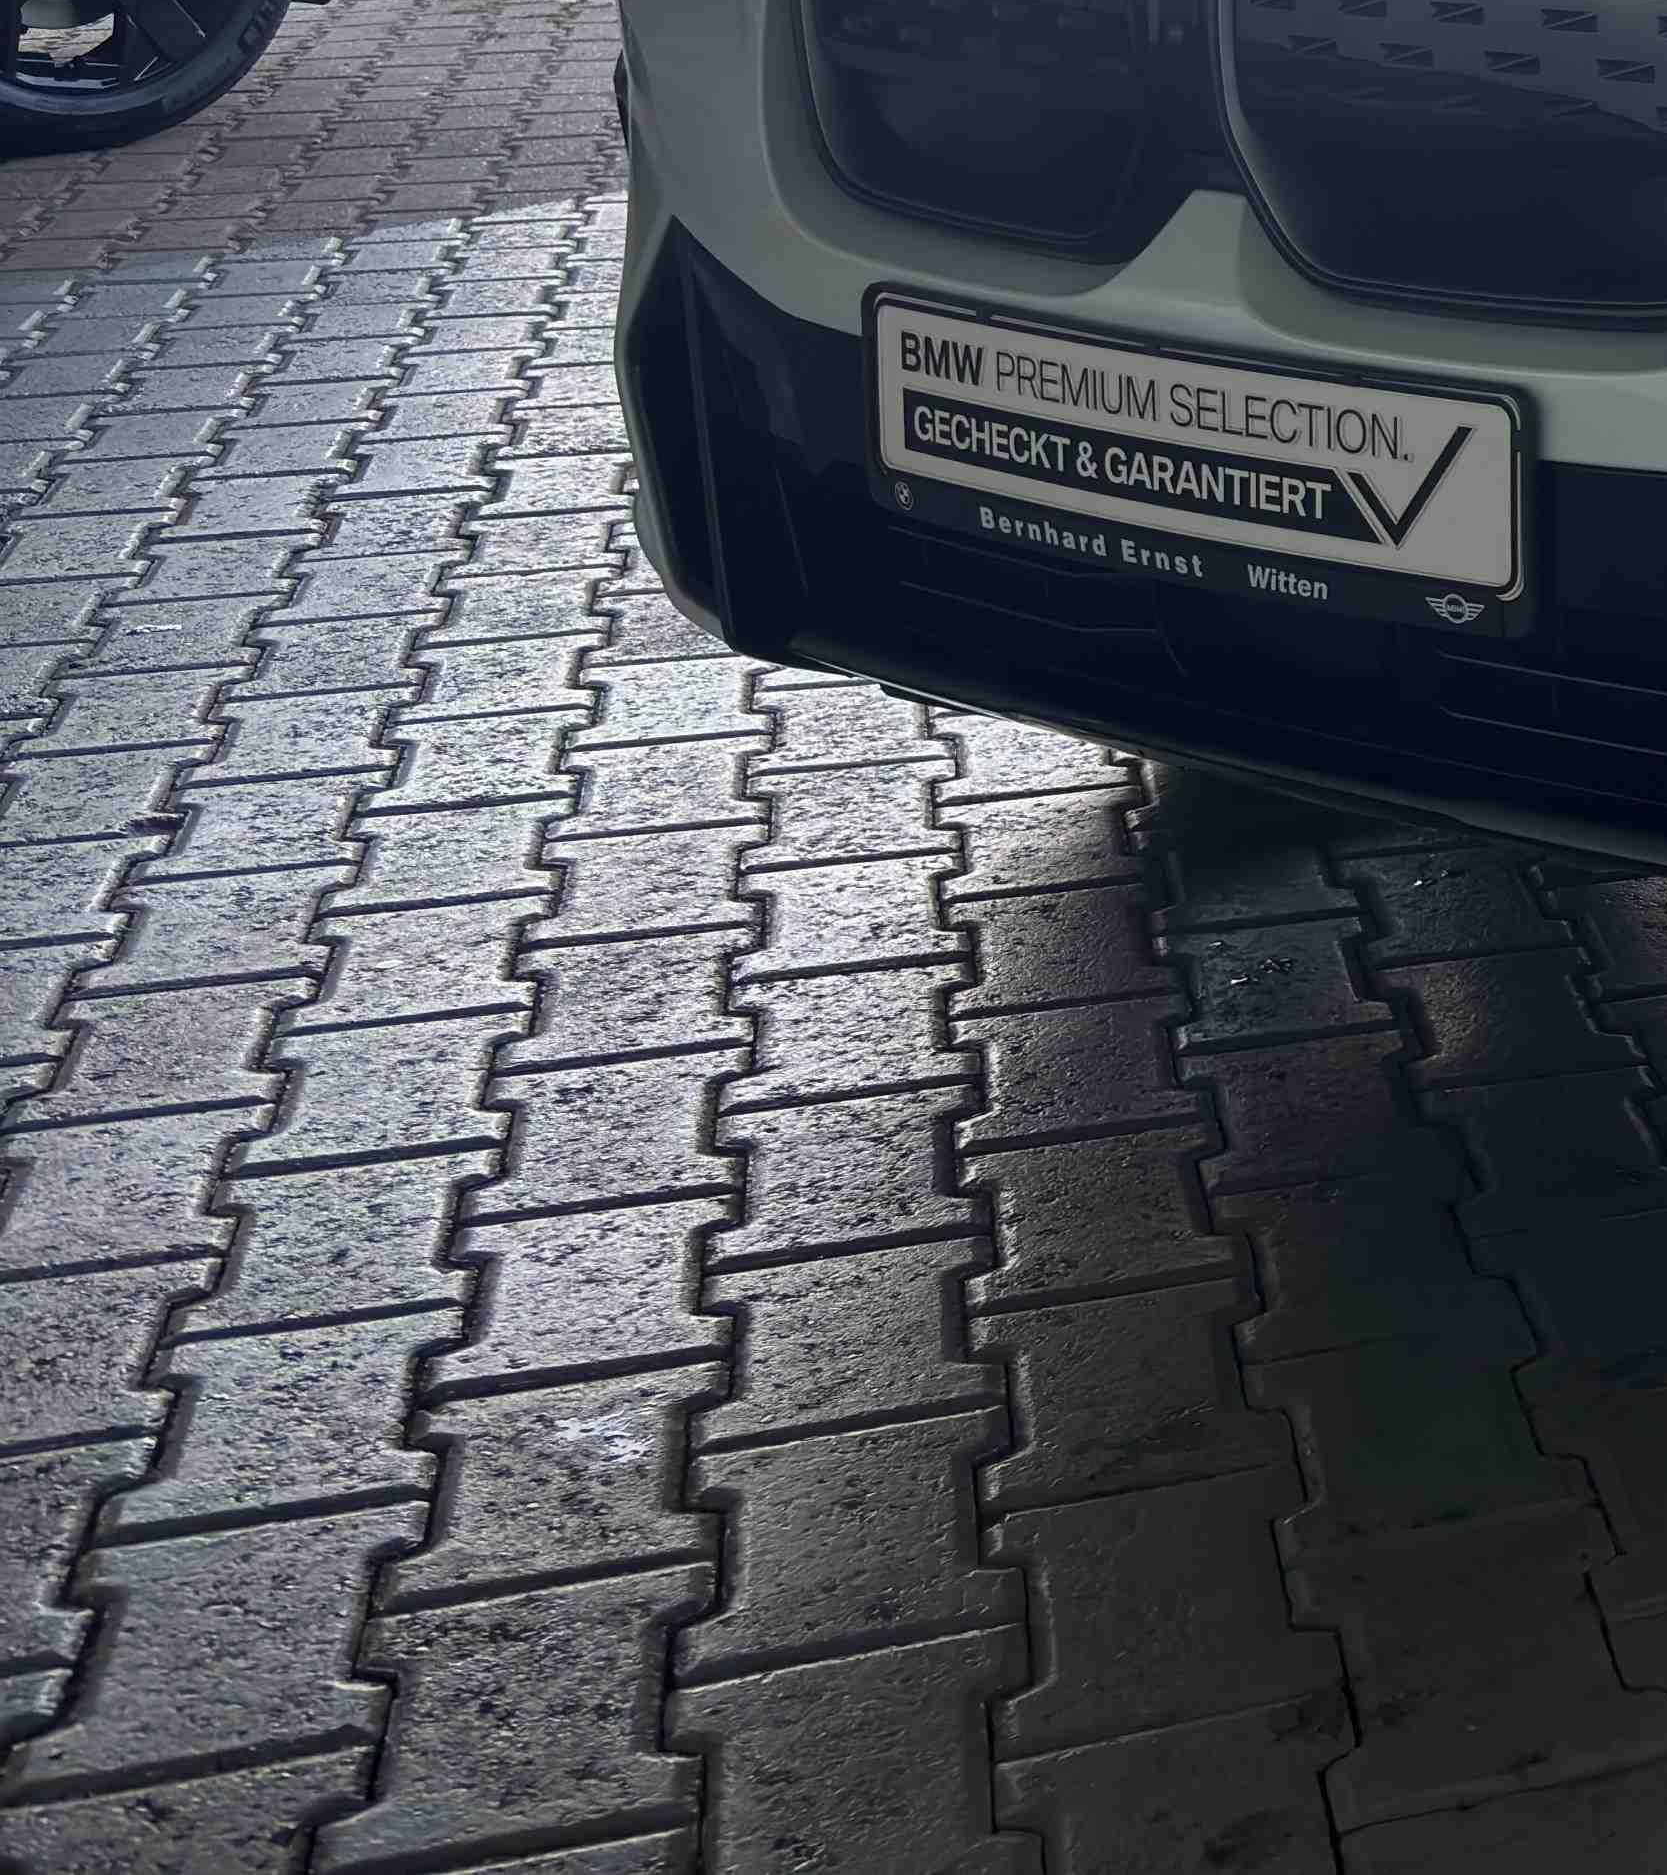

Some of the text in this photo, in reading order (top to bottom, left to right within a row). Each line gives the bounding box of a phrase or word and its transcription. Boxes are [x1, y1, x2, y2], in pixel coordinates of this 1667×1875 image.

[901, 330, 983, 386] BMW
[996, 351, 1158, 422] PREMIUM
[914, 405, 1332, 520] GECHECKT & GARANTIERT
[979, 506, 1329, 600] Bernhard Ernst Witten
